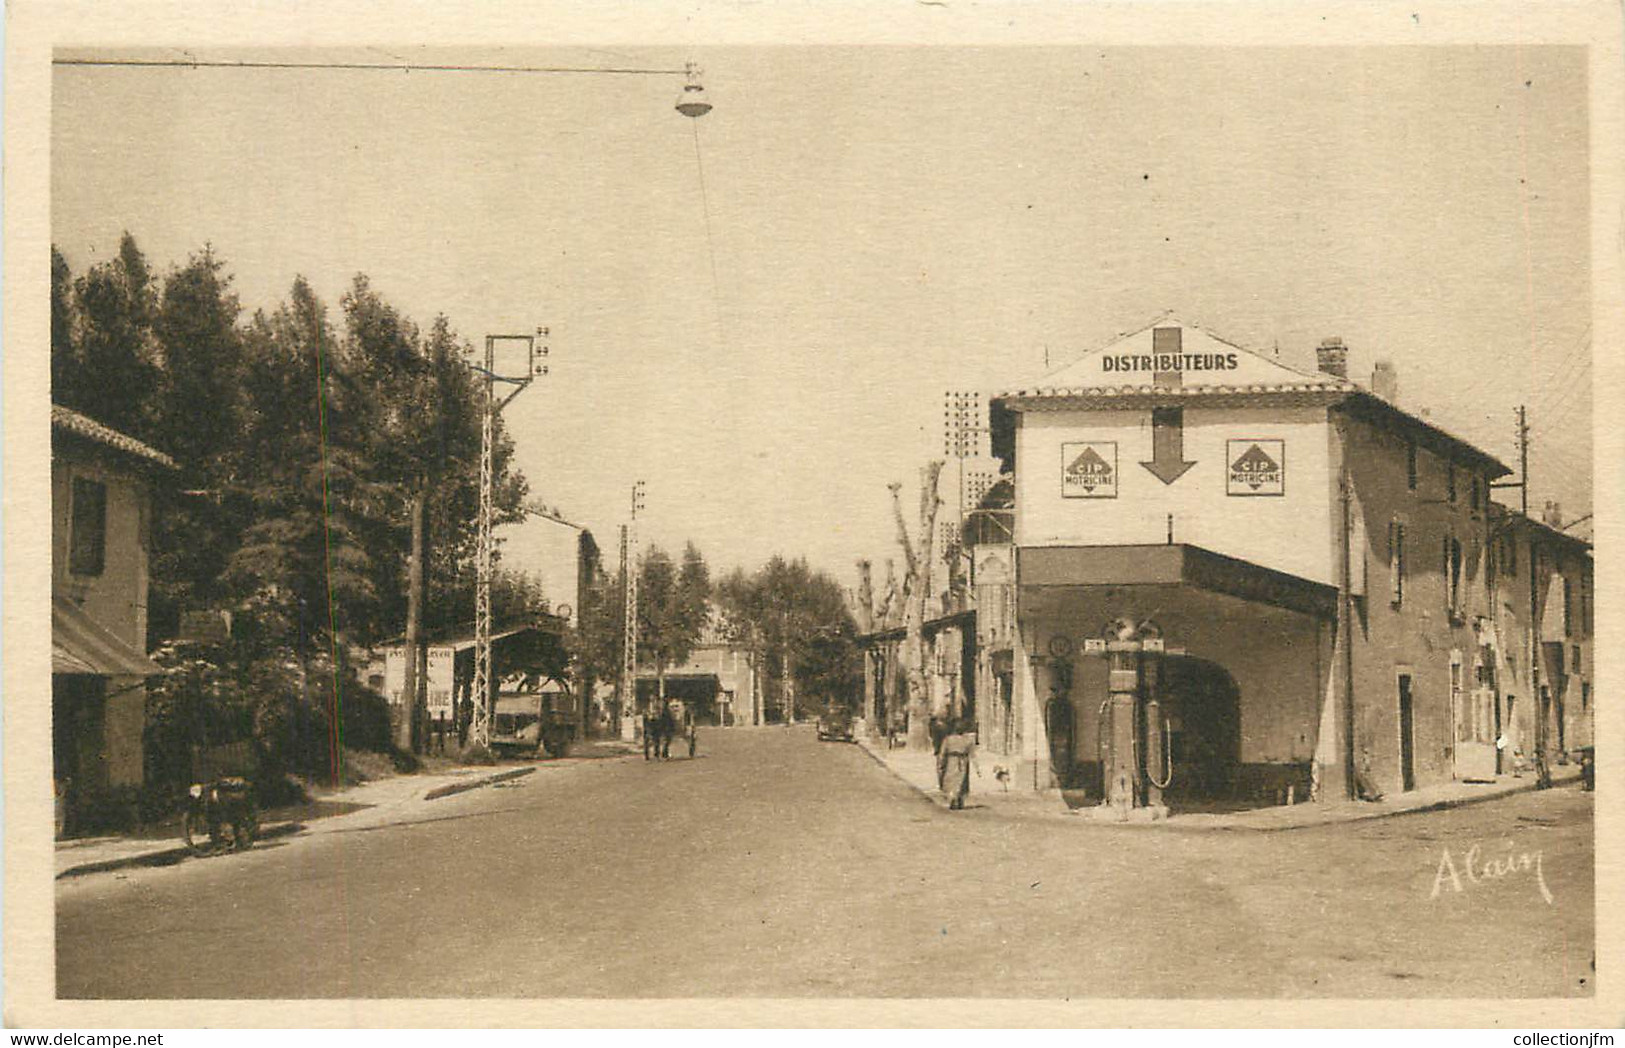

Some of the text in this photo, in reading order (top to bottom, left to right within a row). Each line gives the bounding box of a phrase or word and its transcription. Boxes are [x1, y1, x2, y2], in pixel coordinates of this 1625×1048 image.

[1102, 354, 1238, 372] DISTRIBUTEURS
[1065, 475, 1113, 485] MOTRICINE
[1230, 473, 1280, 483] MOTRICINE
